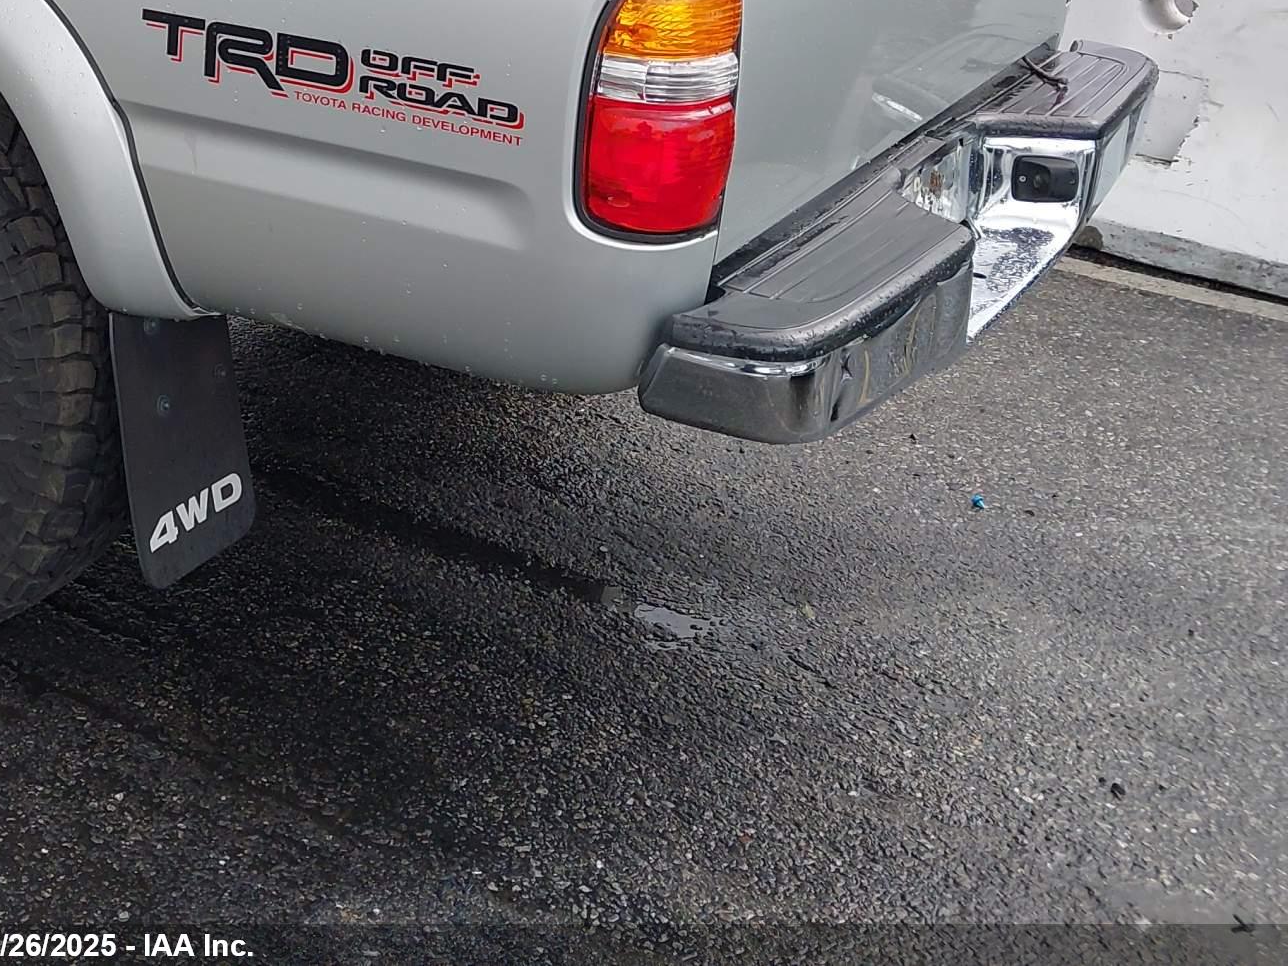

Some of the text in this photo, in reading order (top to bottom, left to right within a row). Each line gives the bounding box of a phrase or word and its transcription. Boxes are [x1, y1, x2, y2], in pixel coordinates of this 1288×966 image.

[141, 8, 354, 98] TRD
[360, 48, 481, 87] OFF
[293, 90, 524, 147] TOYOTA RACING DEVELOPMENT
[359, 74, 524, 131] ROAD
[149, 472, 243, 554] 4WD
